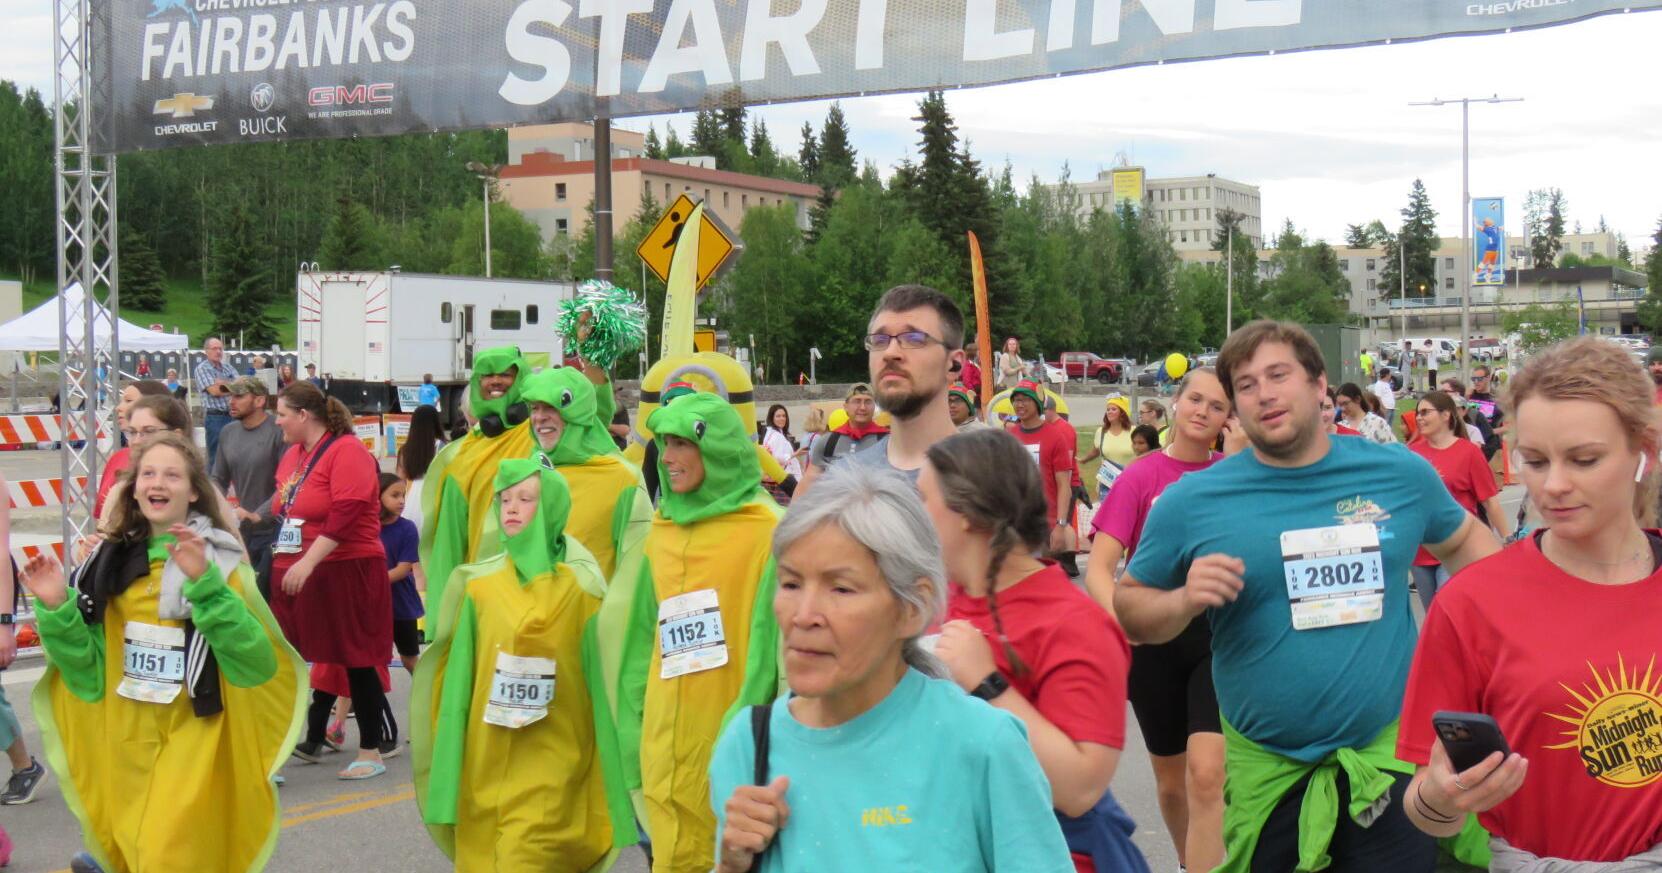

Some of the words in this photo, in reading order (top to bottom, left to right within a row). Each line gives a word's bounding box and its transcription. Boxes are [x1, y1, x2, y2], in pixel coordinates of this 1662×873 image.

[195, 0, 299, 11] CHEVRO
[1466, 0, 1575, 16] CHEVROL
[141, 0, 416, 81] FAIRBANKS
[497, 0, 888, 106] START
[962, 0, 1303, 62] LI
[308, 83, 394, 107] GMC
[154, 121, 218, 136] CHEVROLET
[239, 116, 287, 136] BUICK
[1304, 562, 1365, 589] 2802
[668, 621, 707, 645] 1152
[131, 651, 166, 673] 1151
[500, 682, 539, 700] 1150
[1588, 708, 1659, 750] Midnight
[1581, 741, 1632, 779] Sun
